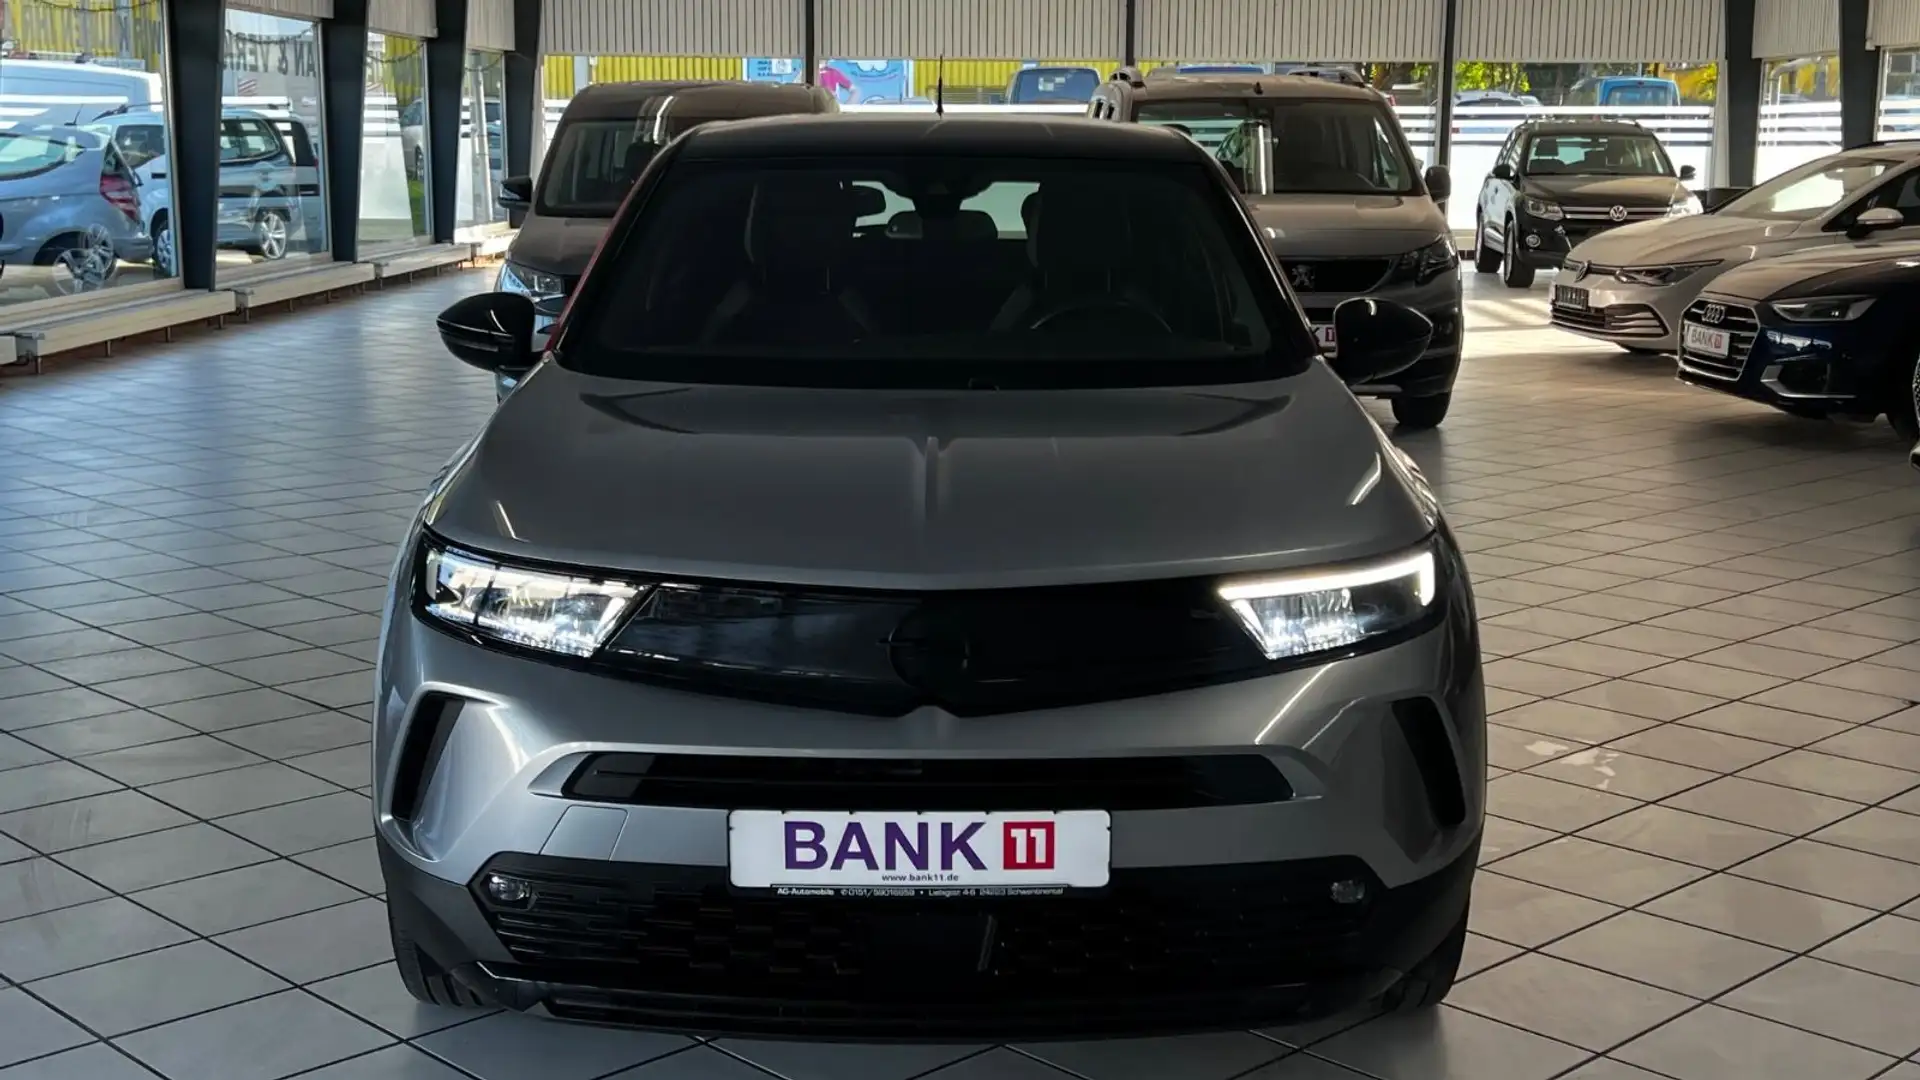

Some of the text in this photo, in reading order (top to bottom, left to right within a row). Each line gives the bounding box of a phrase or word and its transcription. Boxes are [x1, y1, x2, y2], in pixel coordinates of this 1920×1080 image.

[783, 821, 1048, 871] BANK 11
[881, 873, 959, 882] www.bank11.de
